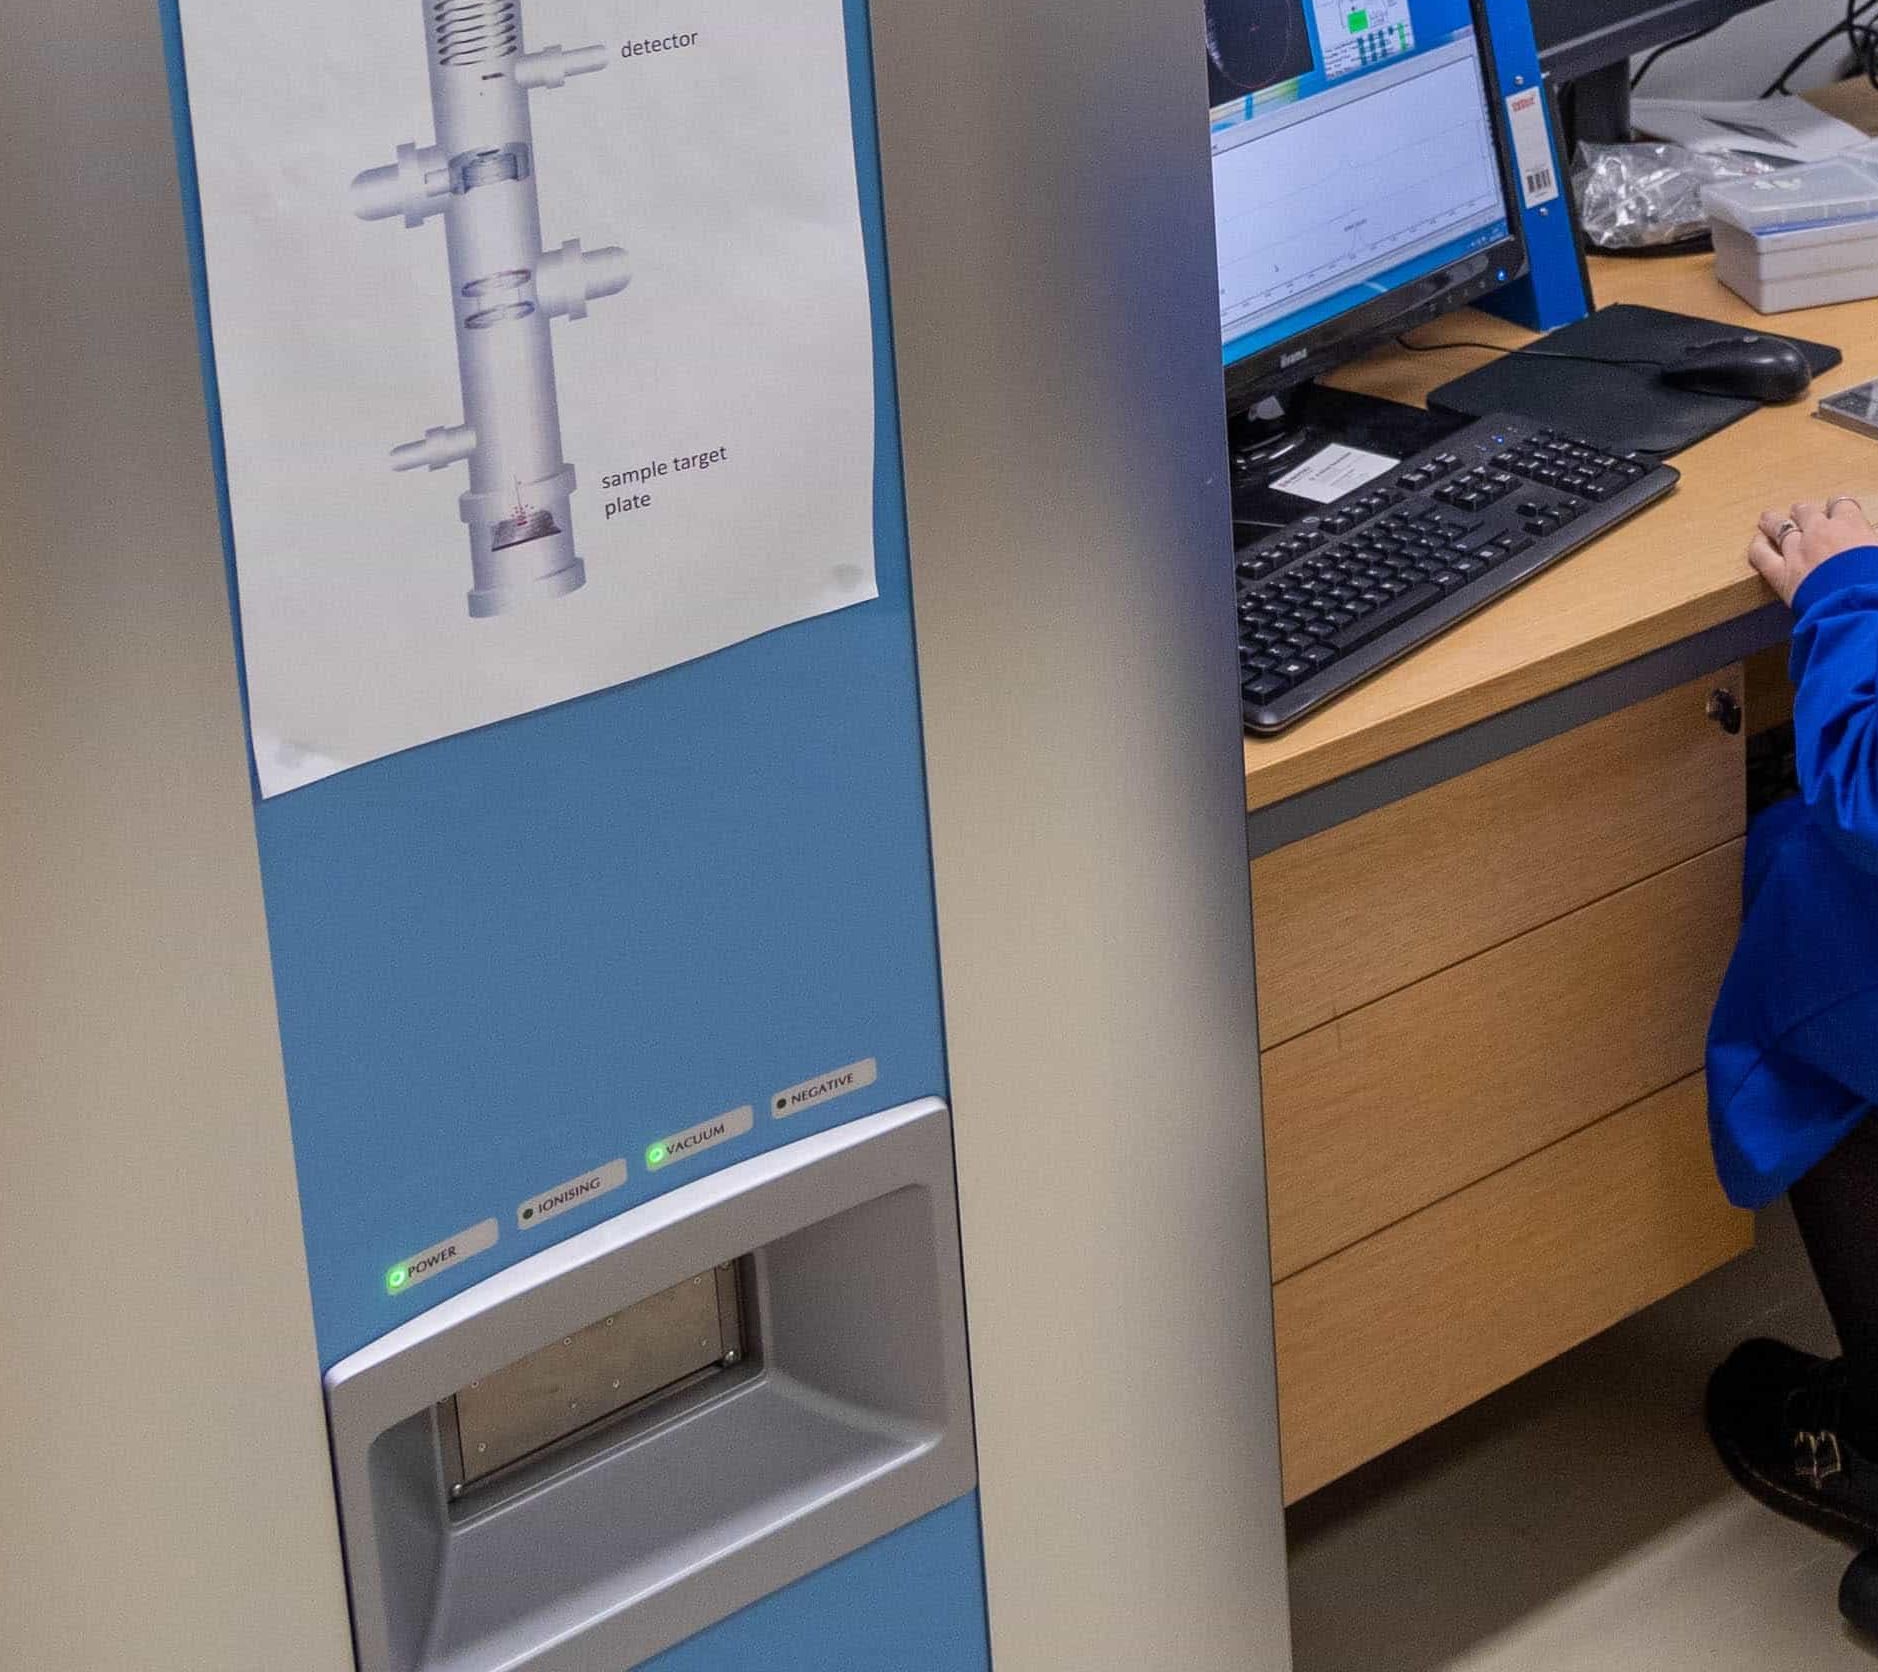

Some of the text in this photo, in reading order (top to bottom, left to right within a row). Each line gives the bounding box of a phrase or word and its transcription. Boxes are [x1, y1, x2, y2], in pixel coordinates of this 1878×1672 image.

[620, 31, 699, 59] detector
[601, 445, 728, 489] sample target
[604, 492, 652, 521] plate
[790, 1071, 855, 1107] NEGATIVE
[665, 1122, 726, 1159] VACUUM
[537, 1175, 602, 1215] IONISING
[406, 1244, 458, 1279] POWER
